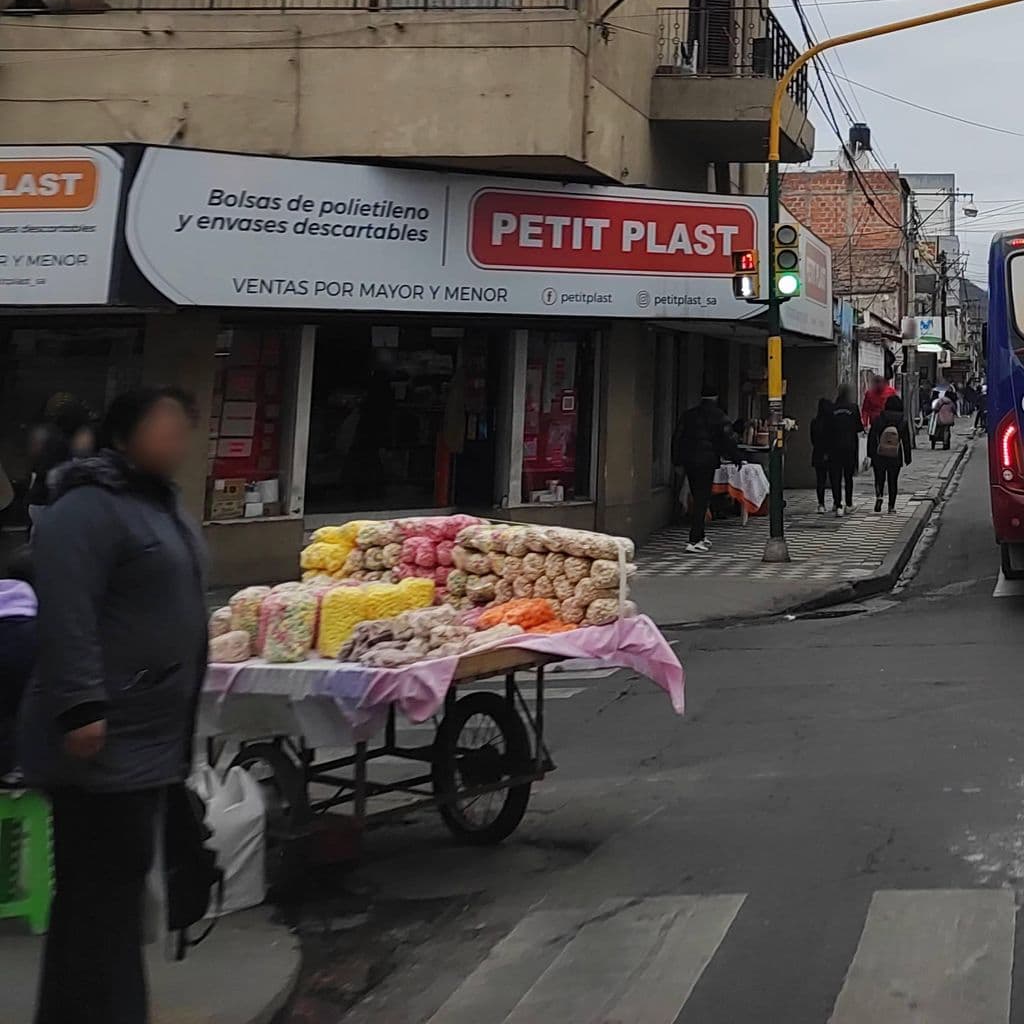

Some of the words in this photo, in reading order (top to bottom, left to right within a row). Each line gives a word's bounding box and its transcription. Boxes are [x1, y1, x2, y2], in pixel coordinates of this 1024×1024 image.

[207, 188, 282, 211] Bolsas
[286, 194, 315, 213] de
[318, 197, 430, 220] polietileno
[174, 214, 194, 233] y
[196, 215, 289, 234] envases
[292, 217, 430, 243] descartables
[491, 212, 610, 251] PETIT
[621, 220, 739, 257] PLAST
[12, 254, 24, 267] Y
[26, 254, 89, 267] MENOR
[232, 277, 310, 296] VENTAS
[314, 280, 355, 298] POR
[359, 282, 425, 300] MAYOR
[428, 285, 441, 301] Y
[444, 286, 508, 303] MENOR
[560, 291, 613, 307] petitplast
[653, 293, 718, 308] petitplast_sa
